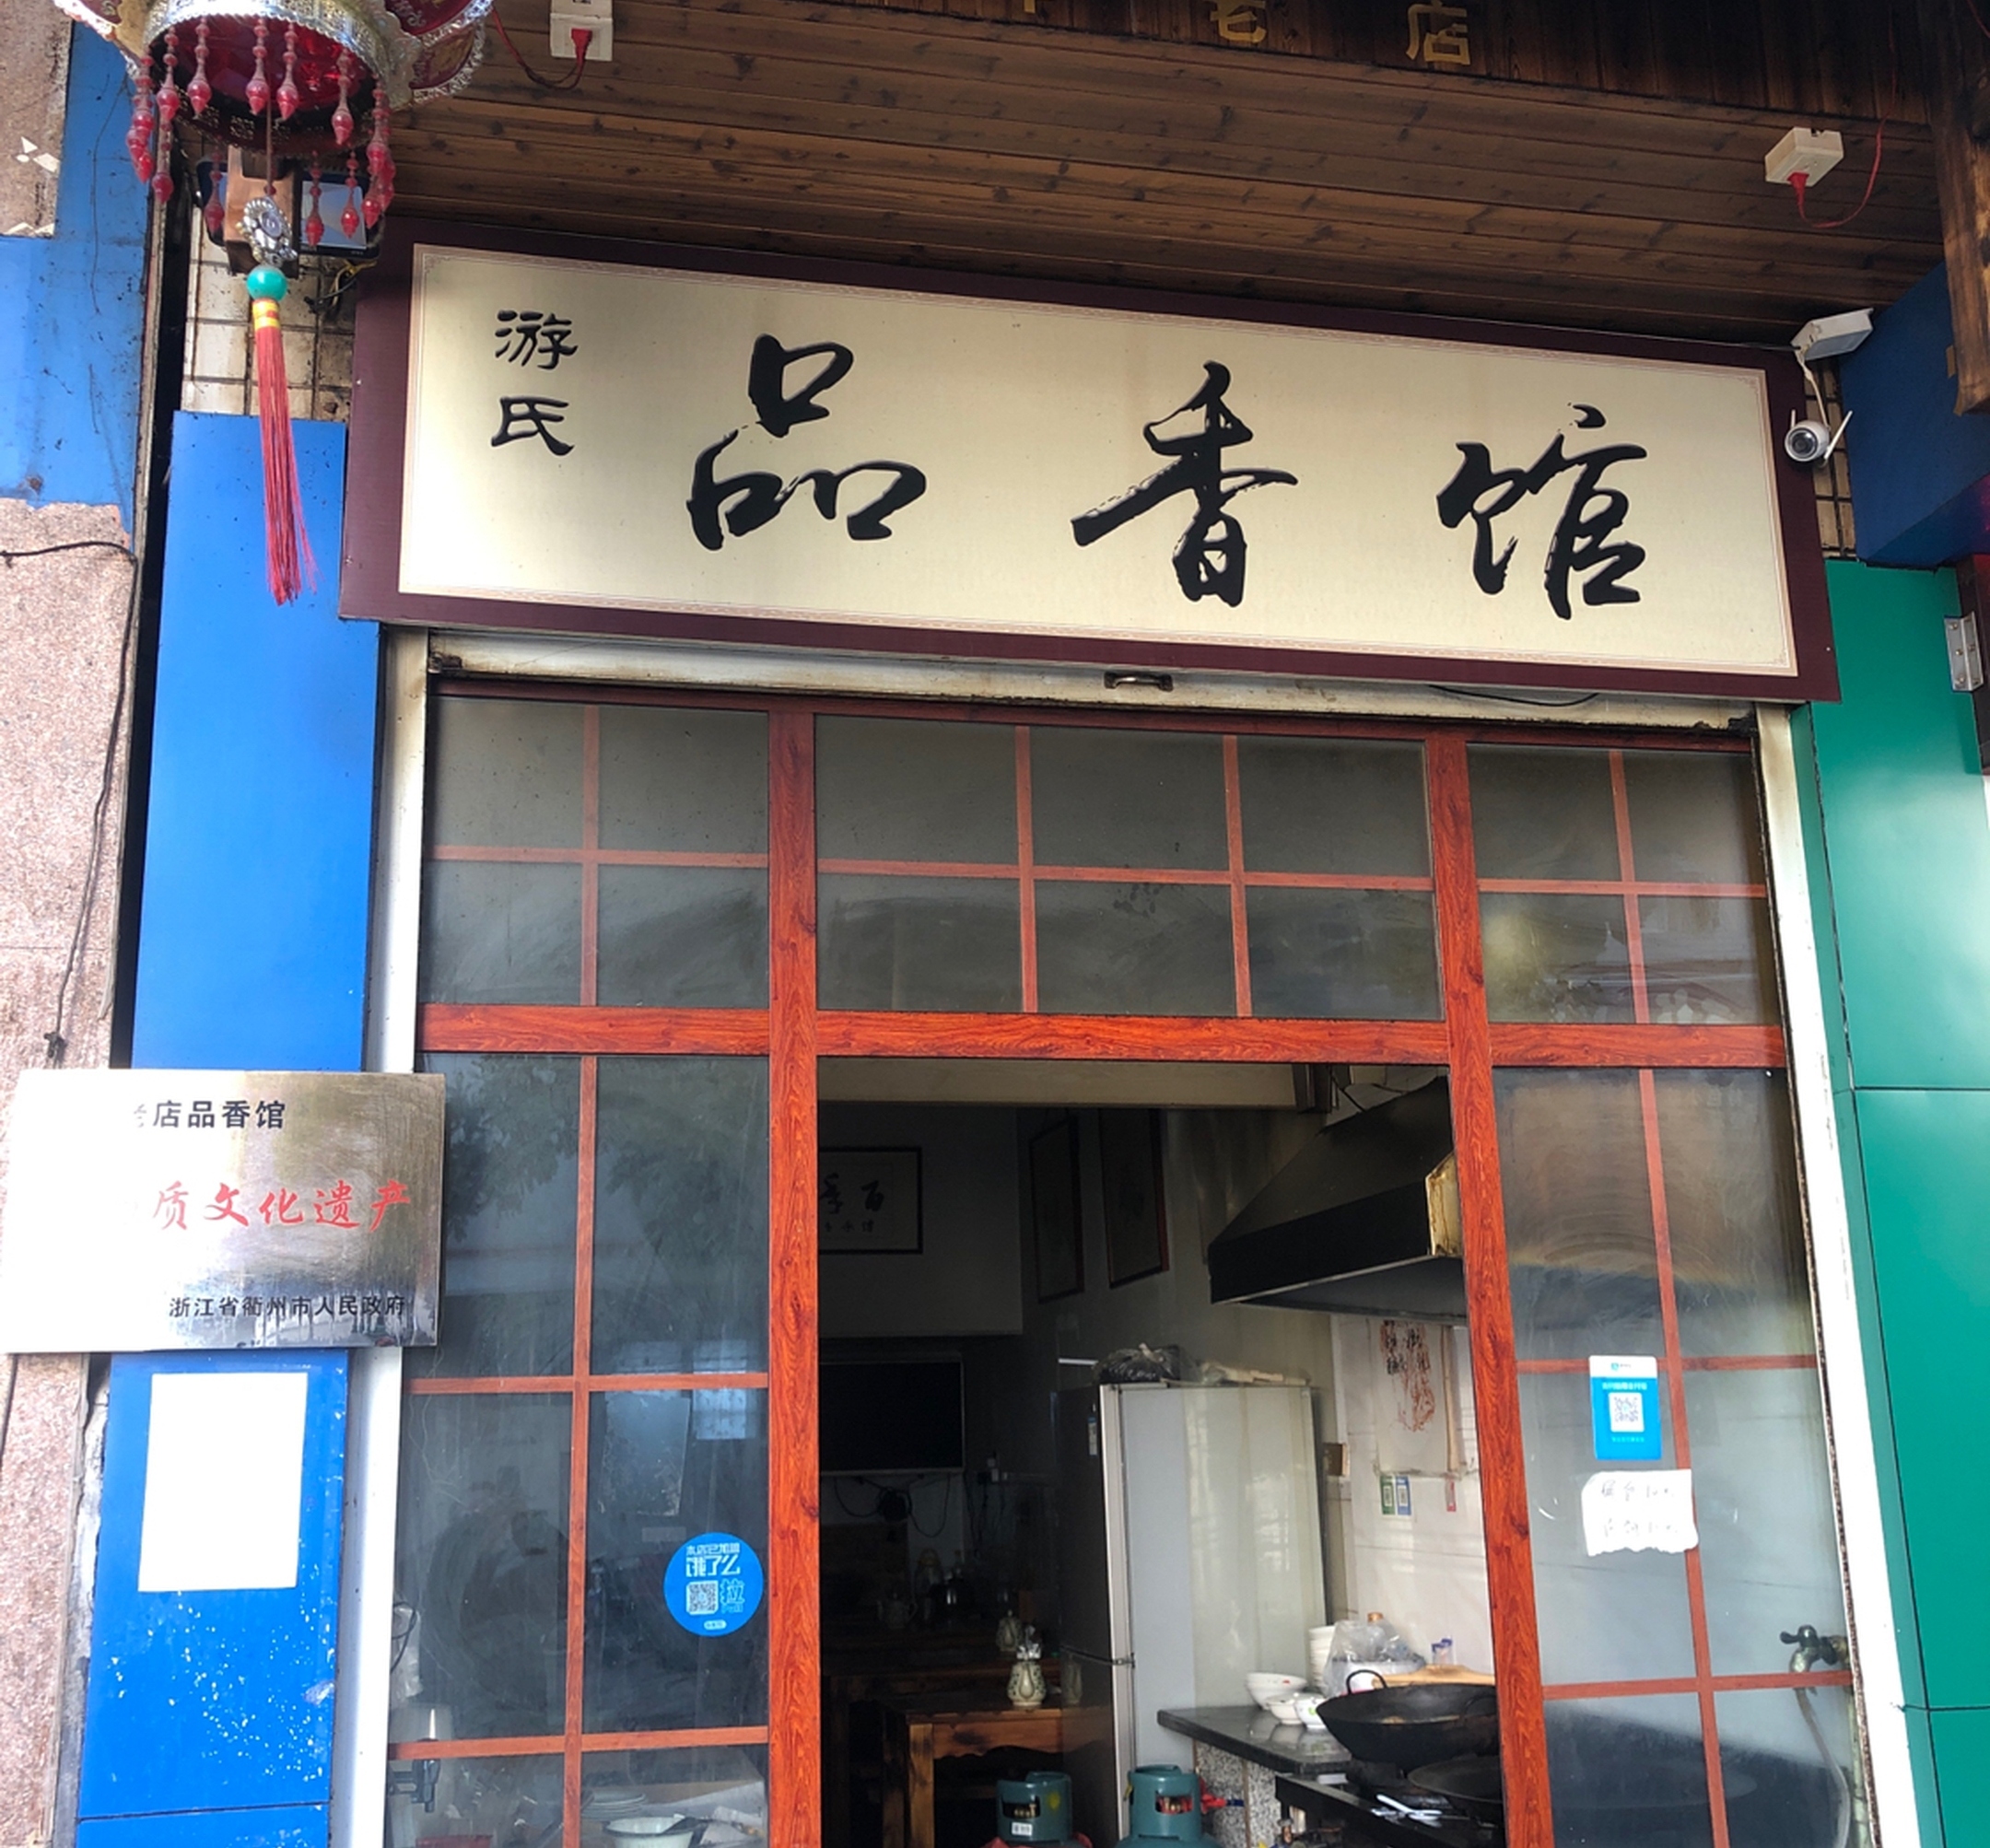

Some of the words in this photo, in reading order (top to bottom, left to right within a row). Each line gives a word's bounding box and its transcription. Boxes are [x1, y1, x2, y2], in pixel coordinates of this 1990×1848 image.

[685, 333, 1647, 620] 品香馆
[134, 1099, 287, 1129] 店品香馆
[169, 1294, 405, 1318] 浙江省衢州市人民政府
[685, 1554, 741, 1577] 饿了么
